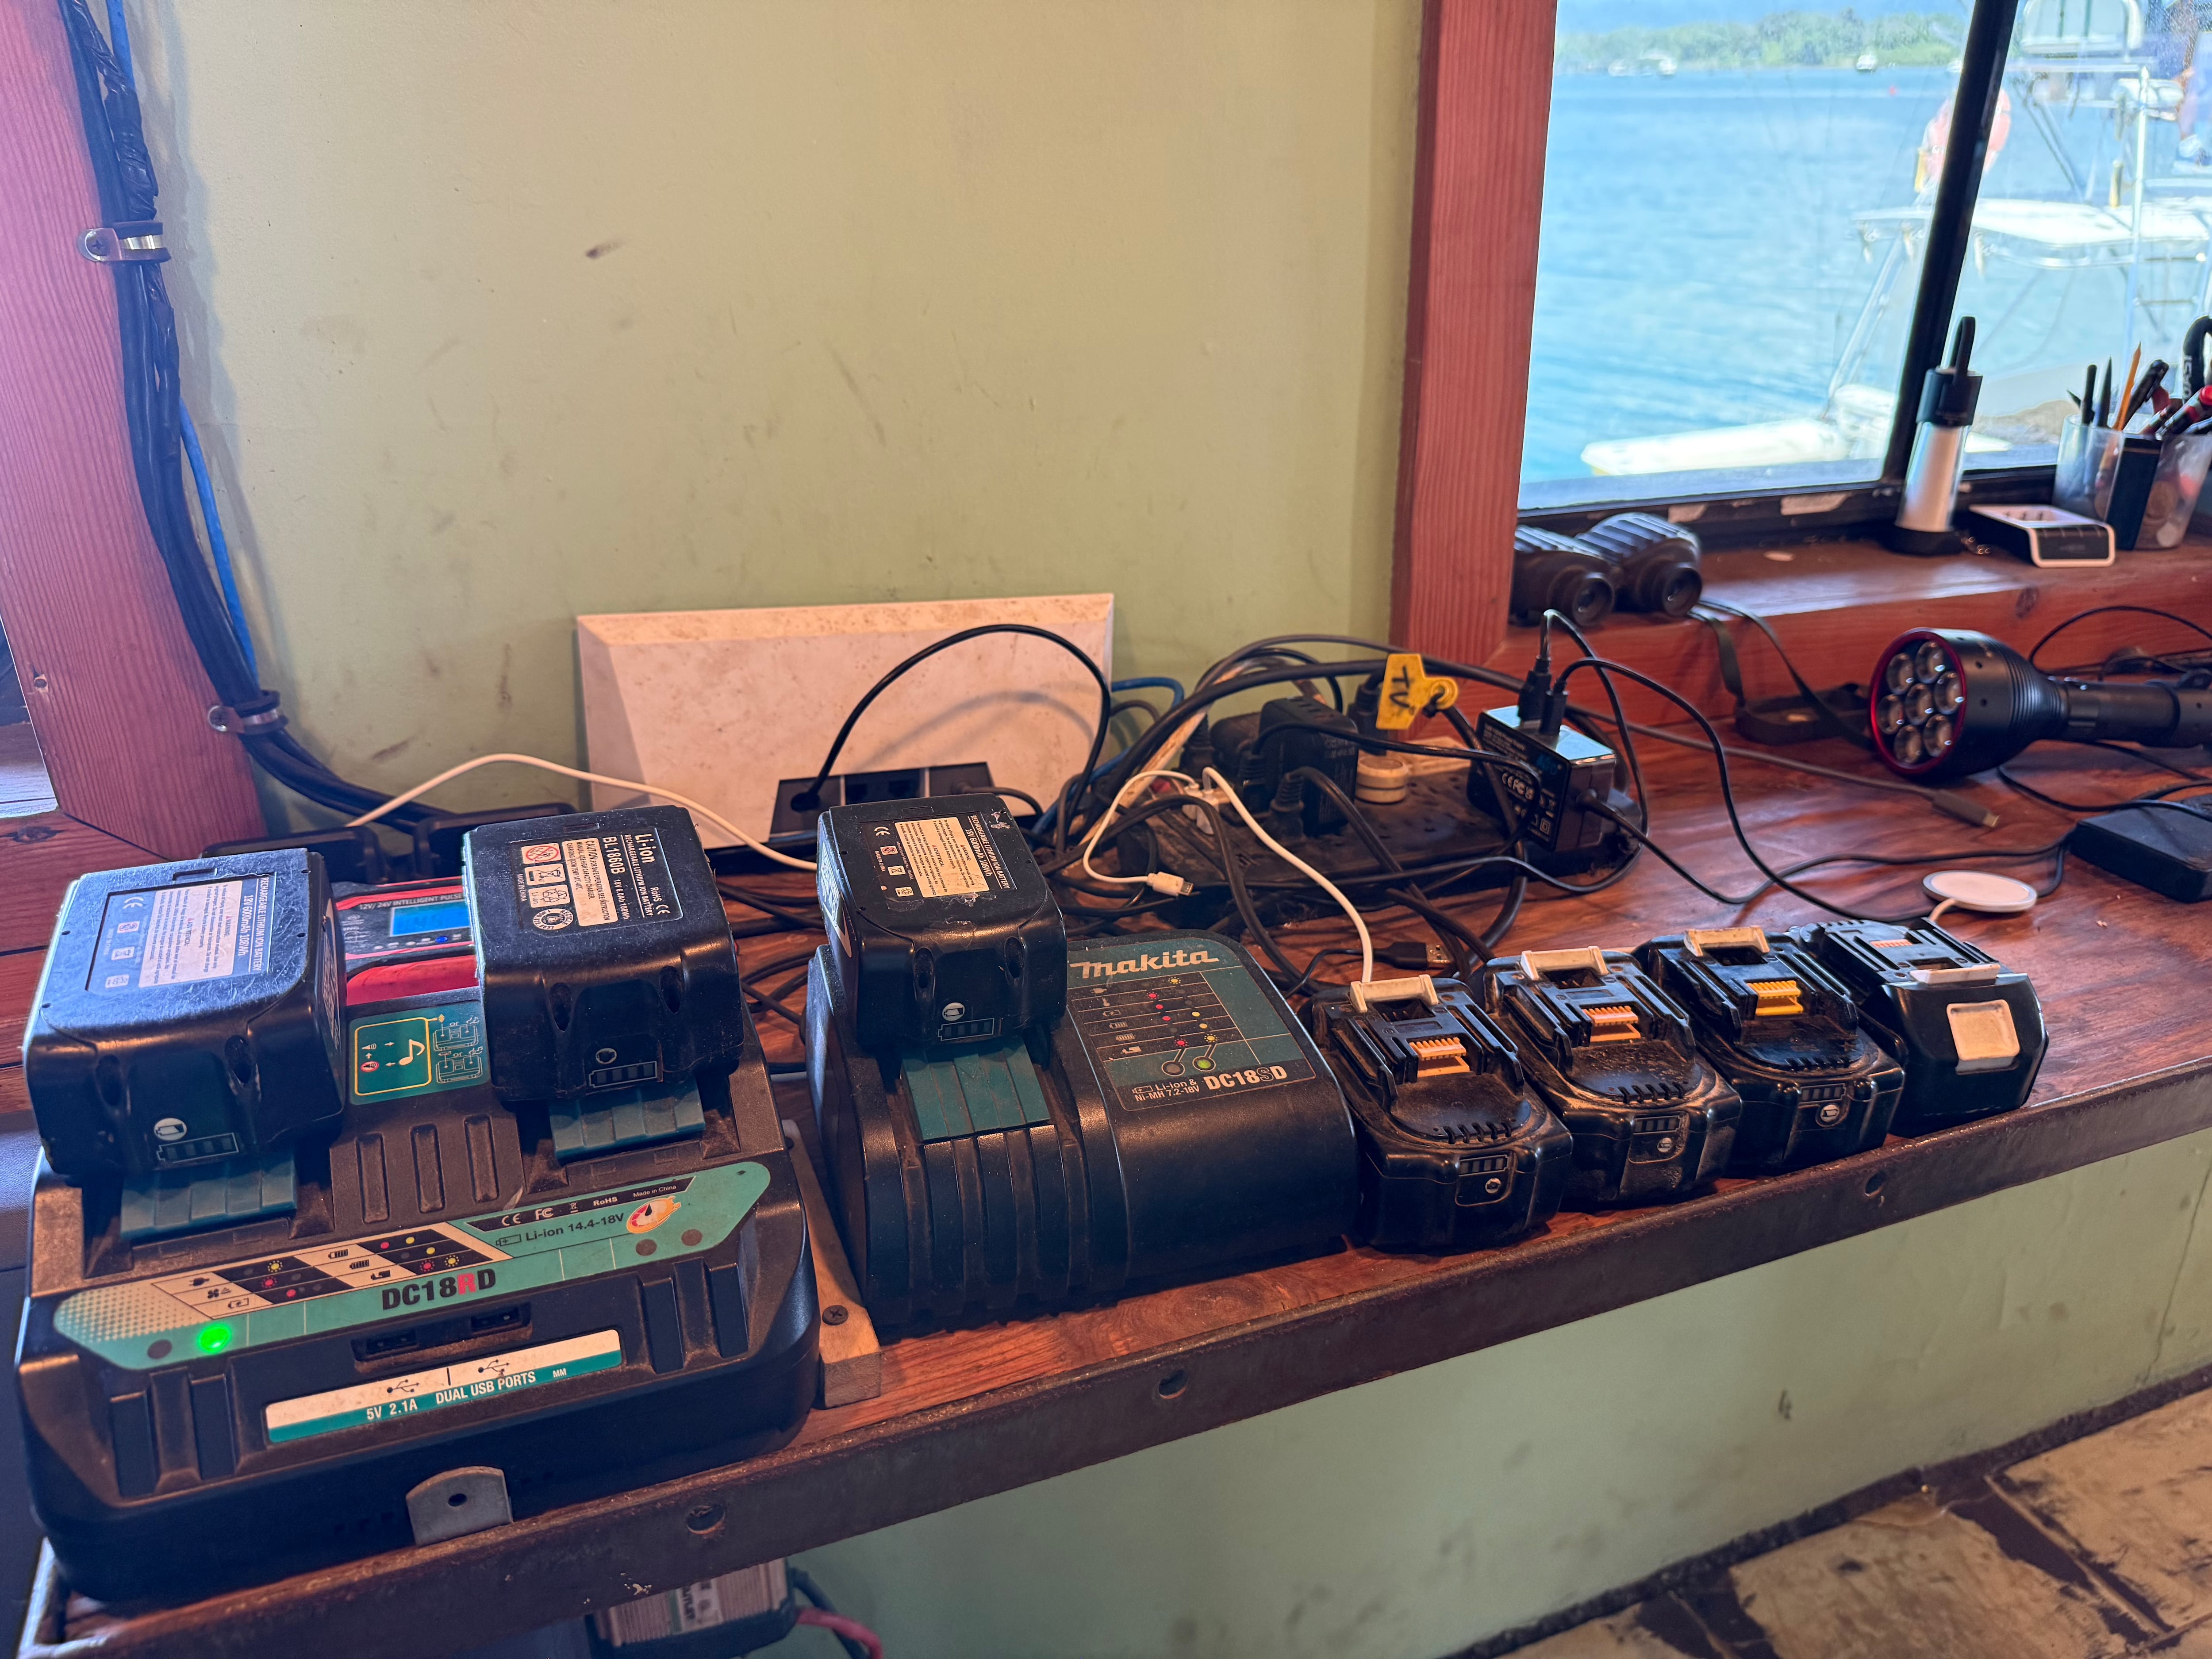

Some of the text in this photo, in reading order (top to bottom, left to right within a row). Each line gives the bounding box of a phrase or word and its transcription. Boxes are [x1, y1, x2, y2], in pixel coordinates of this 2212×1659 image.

[1389, 665, 1415, 708] TV
[602, 836, 626, 874] BL1860B
[635, 833, 656, 863] Li-ion
[965, 829, 993, 876] 18V 6000mAh 108Wh
[970, 815, 990, 844] RECHARGEABLE
[983, 845, 997, 861] LITHIUM
[995, 870, 1010, 888] BATTERY
[582, 868, 591, 883] CAPACITY
[624, 834, 653, 916] RECHARGEABLE LITHIUM ION BATTERY
[393, 896, 438, 906] INTELLIGENT
[615, 888, 626, 902] 6.0Ah
[649, 887, 662, 902] RoHS
[599, 899, 610, 920] INSTRUCTION
[619, 903, 630, 919] 108Wh
[237, 894, 254, 956] 18V 6000mAh 108Wh
[252, 877, 269, 971] RECHARGEABLE LITHIUM ION BATTERY
[1069, 950, 1219, 979] makita
[1154, 1080, 1187, 1091] Li-ion
[1203, 1065, 1288, 1091] DC18SD
[1134, 1085, 1200, 1102] Ni-MH 7.2-18V
[593, 1196, 618, 1206] RoHS
[526, 1213, 624, 1241] Li-ion 14.4-18V
[382, 1268, 496, 1310] DC18RD
[366, 1368, 567, 1421] 5V 2.1A DUAL USB PORTS MM
